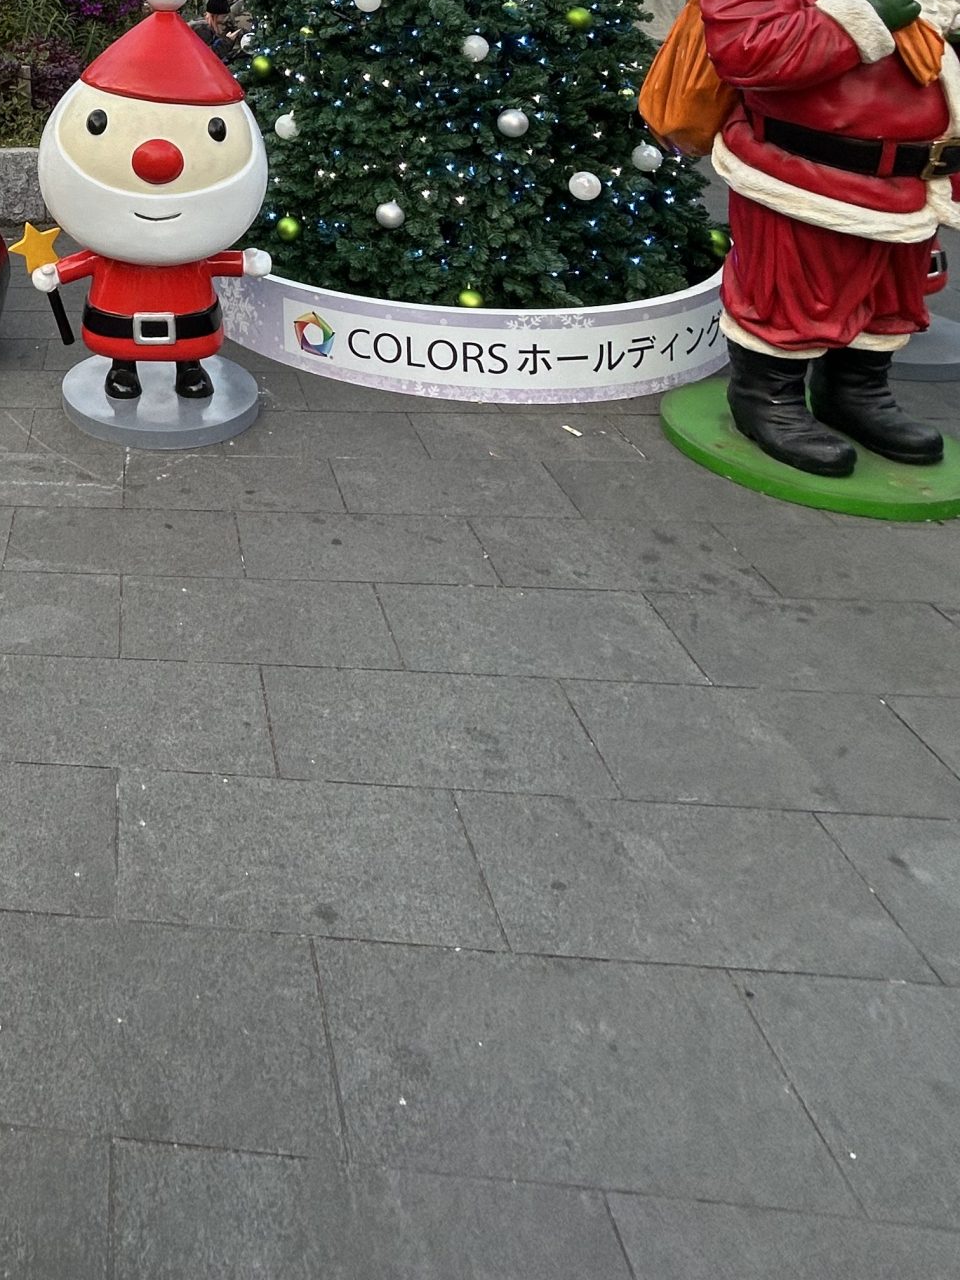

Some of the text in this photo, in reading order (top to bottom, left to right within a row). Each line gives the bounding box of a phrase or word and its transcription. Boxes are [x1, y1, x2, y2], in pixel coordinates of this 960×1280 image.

[347, 309, 725, 375] COLORS ホールディング
